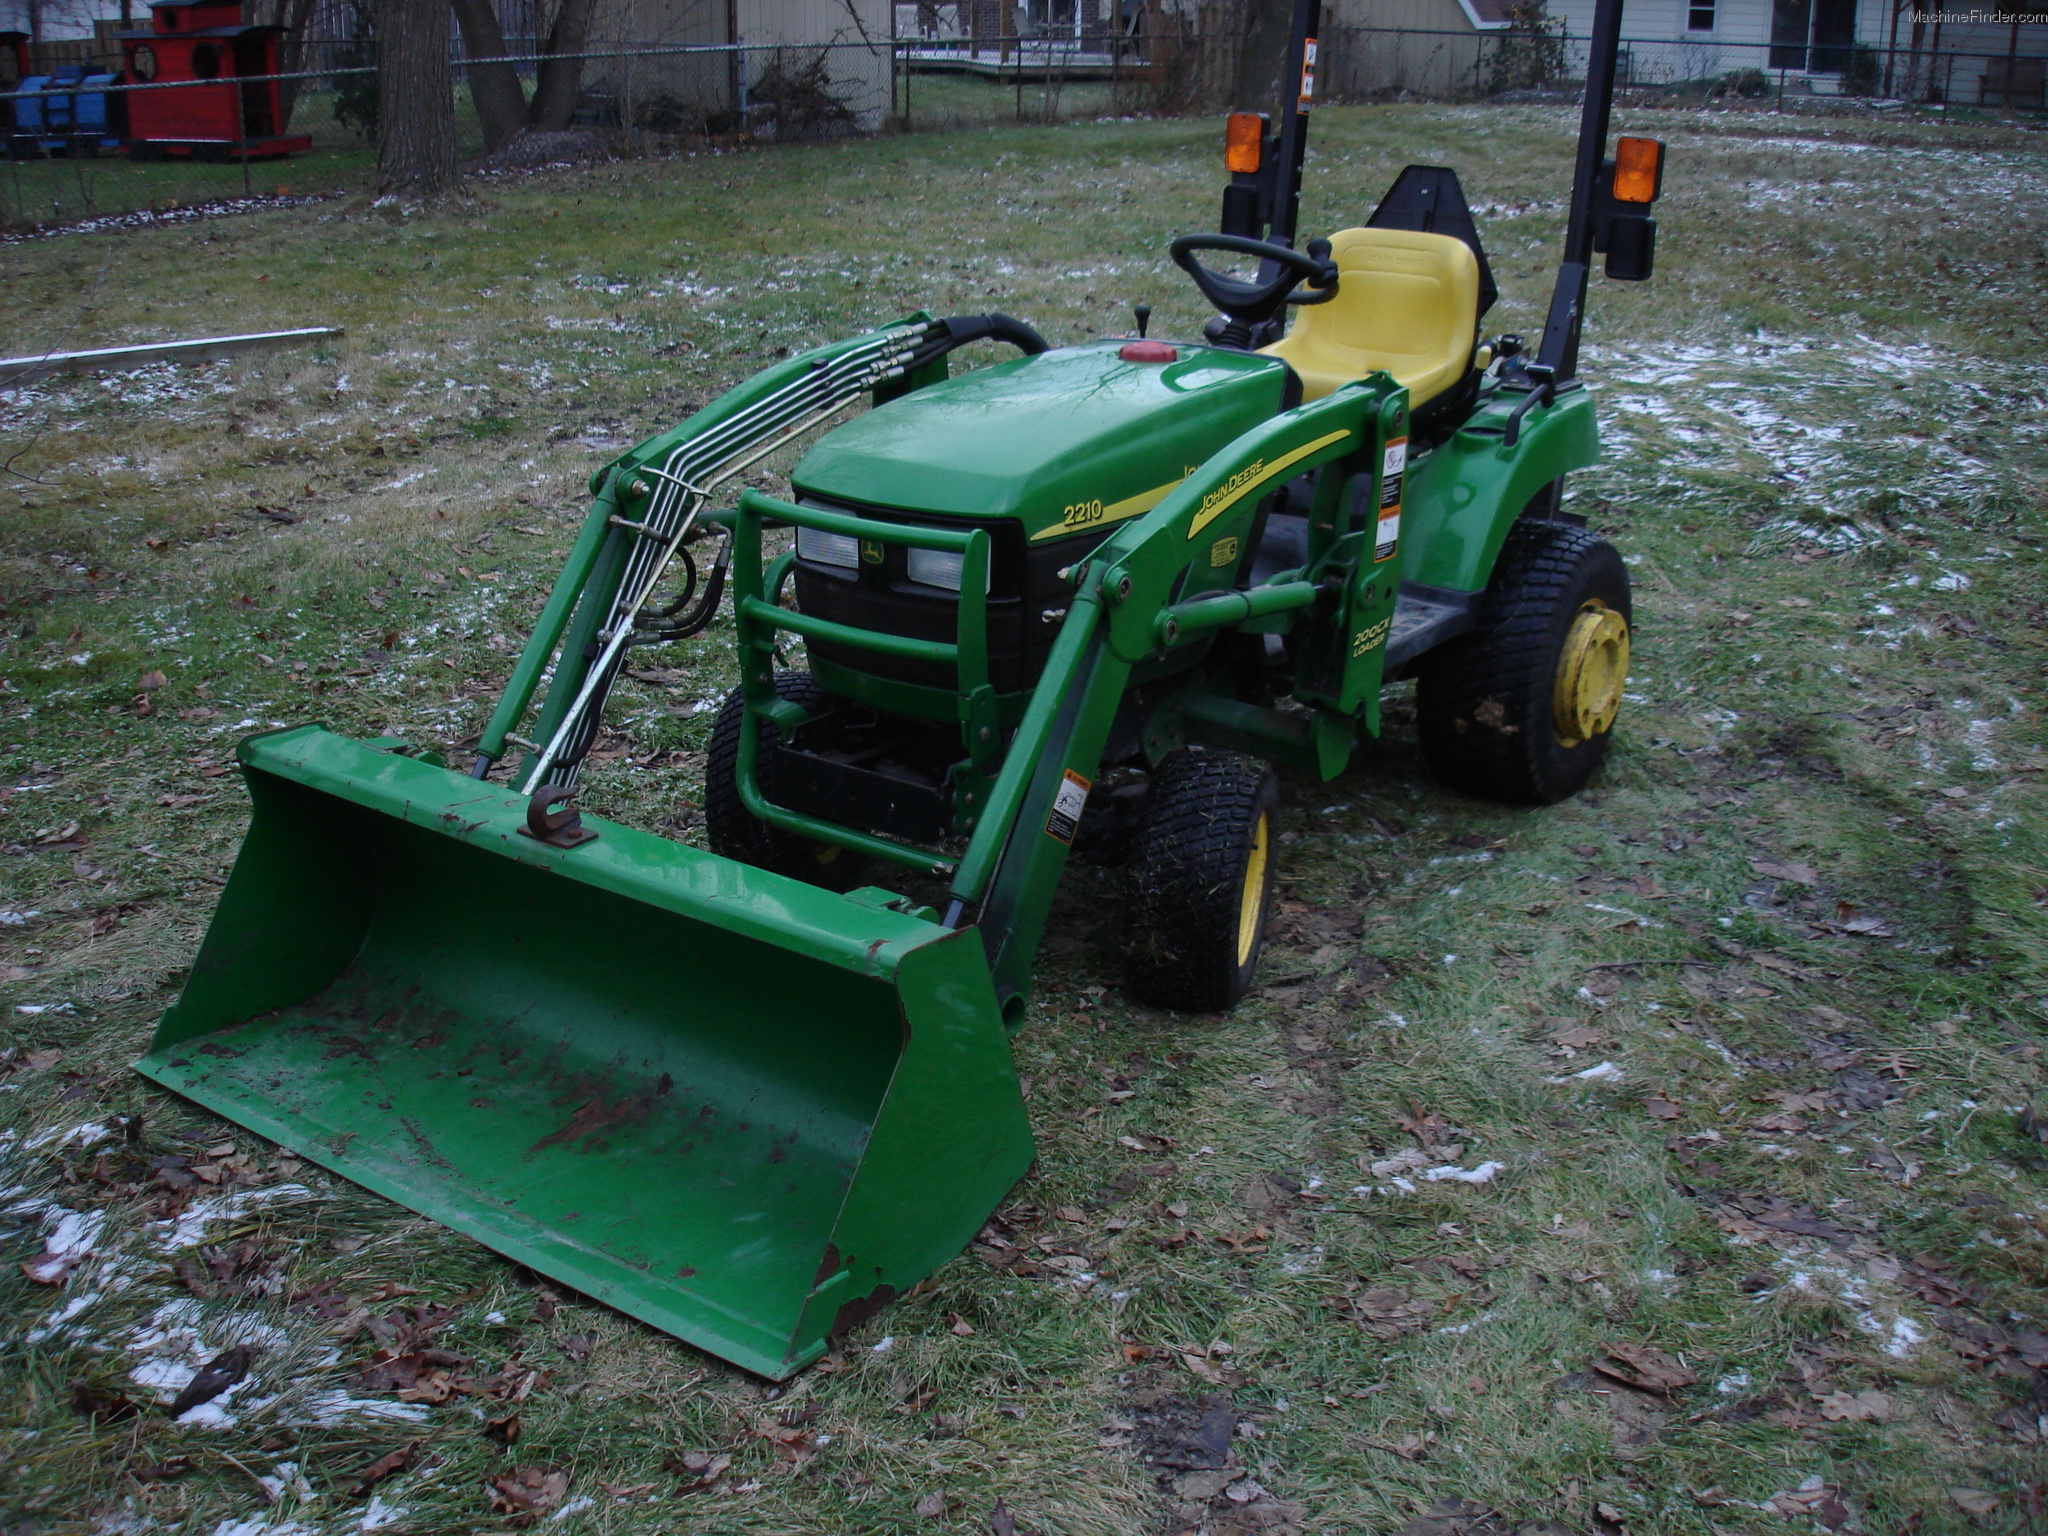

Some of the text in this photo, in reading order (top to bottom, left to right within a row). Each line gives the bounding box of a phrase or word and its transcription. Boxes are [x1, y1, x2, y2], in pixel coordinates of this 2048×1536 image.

[1199, 458, 1264, 515] JOHN DEERE
[1063, 499, 1103, 526] 2210
